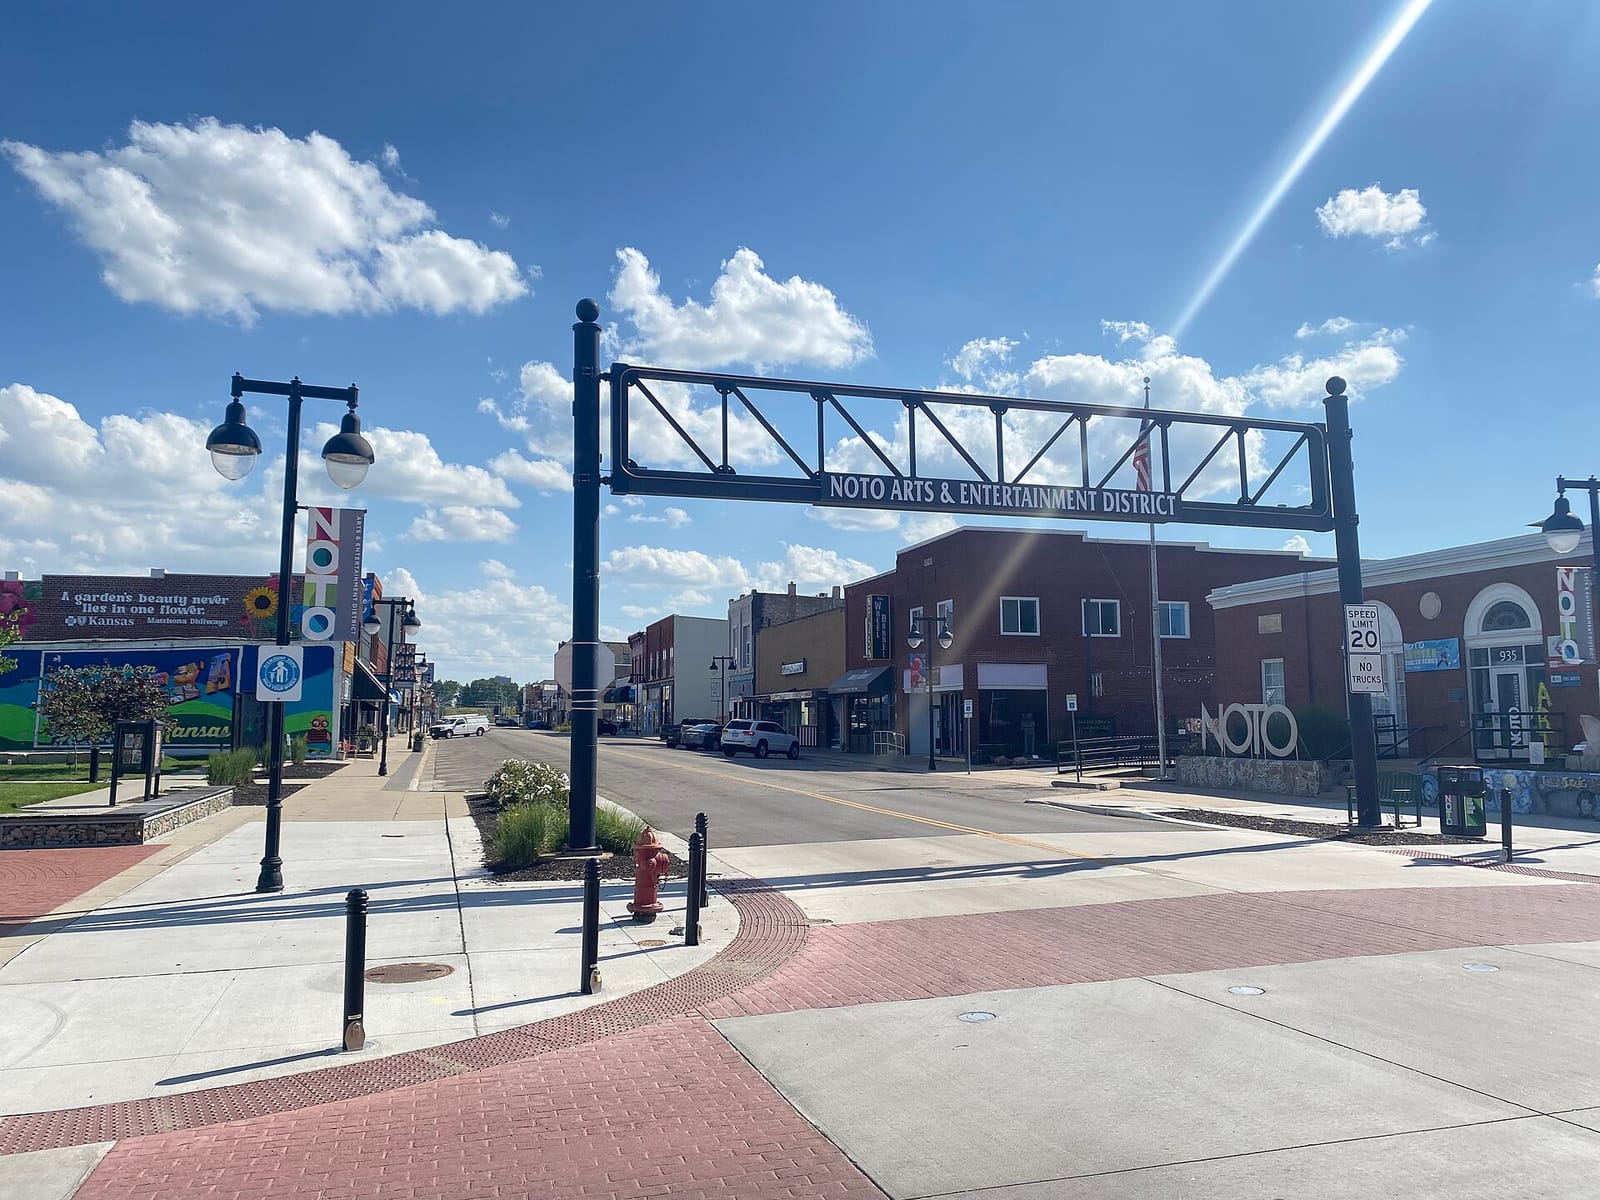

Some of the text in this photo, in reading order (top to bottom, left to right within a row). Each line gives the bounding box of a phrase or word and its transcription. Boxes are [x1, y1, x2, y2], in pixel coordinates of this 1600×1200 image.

[830, 475, 1176, 516] NOTO ARTS & ENTERTAINMENT DISTRICT
[302, 507, 340, 640] NOTO
[352, 543, 361, 601] ENTERTAINMENT
[61, 592, 229, 606] A garden's beauty never
[82, 603, 206, 615] lies in one flower.
[1348, 610, 1376, 619] SPEED
[1557, 568, 1580, 664] NOTO
[88, 616, 135, 626] Kansas
[350, 603, 358, 635] DISTRICT
[1352, 620, 1373, 628] LIMIT
[1350, 630, 1377, 648] 20
[1499, 650, 1517, 661] 935
[1359, 662, 1372, 671] NO
[1352, 675, 1381, 684] TRUCKS
[1201, 702, 1298, 757] NOTO
[1444, 795, 1453, 825] NOTO
